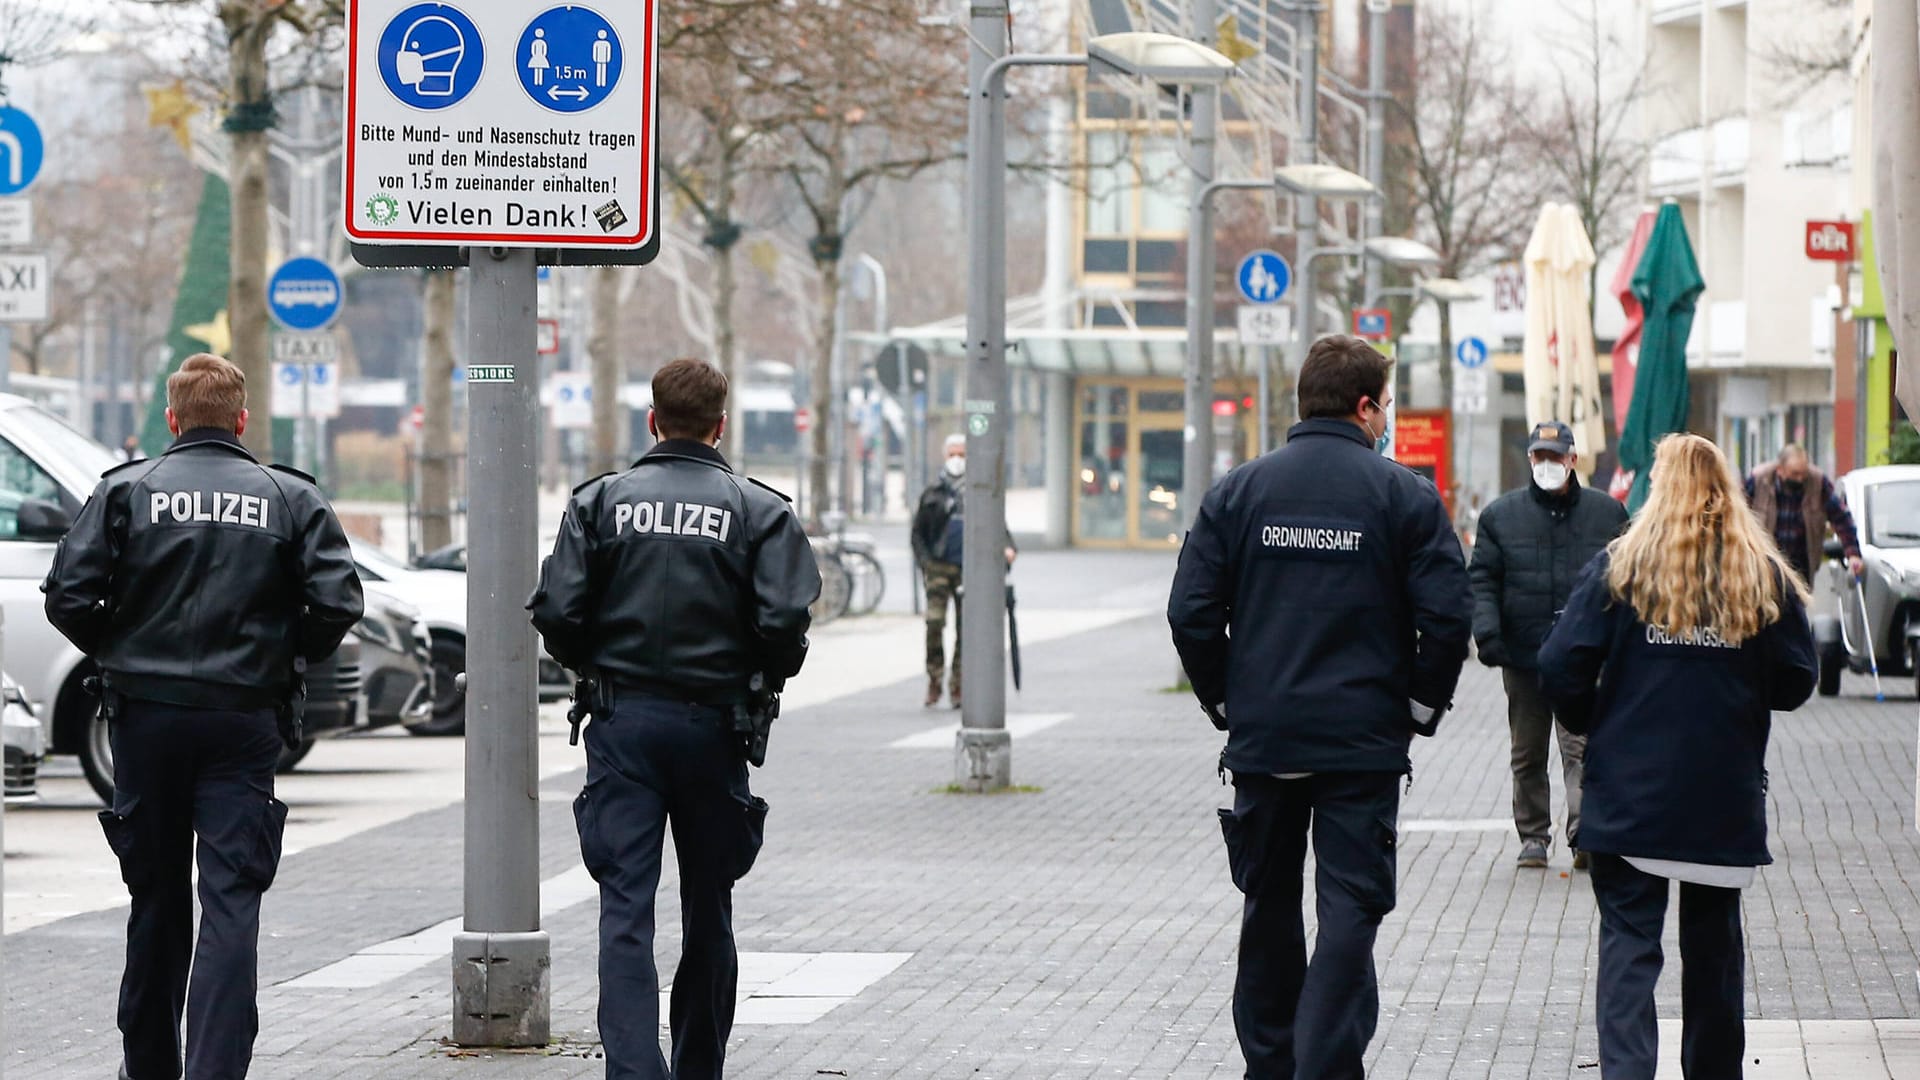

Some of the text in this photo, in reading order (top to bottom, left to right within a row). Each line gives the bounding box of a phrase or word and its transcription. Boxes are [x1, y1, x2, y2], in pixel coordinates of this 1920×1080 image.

[361, 124, 636, 151] Bitte Mund- und Nasenschutz tragen
[408, 149, 587, 169] und den Mindestabstand
[378, 176, 404, 189] von
[455, 174, 535, 192] zueinander
[543, 175, 617, 194] einhalten!
[407, 200, 492, 226] Vielen
[506, 202, 587, 228] Dank!
[1810, 230, 1849, 252] DER
[151, 490, 269, 529] POLIZEI
[615, 501, 732, 543] POLIZEI
[1262, 525, 1362, 551] ORDNUNGSAMT
